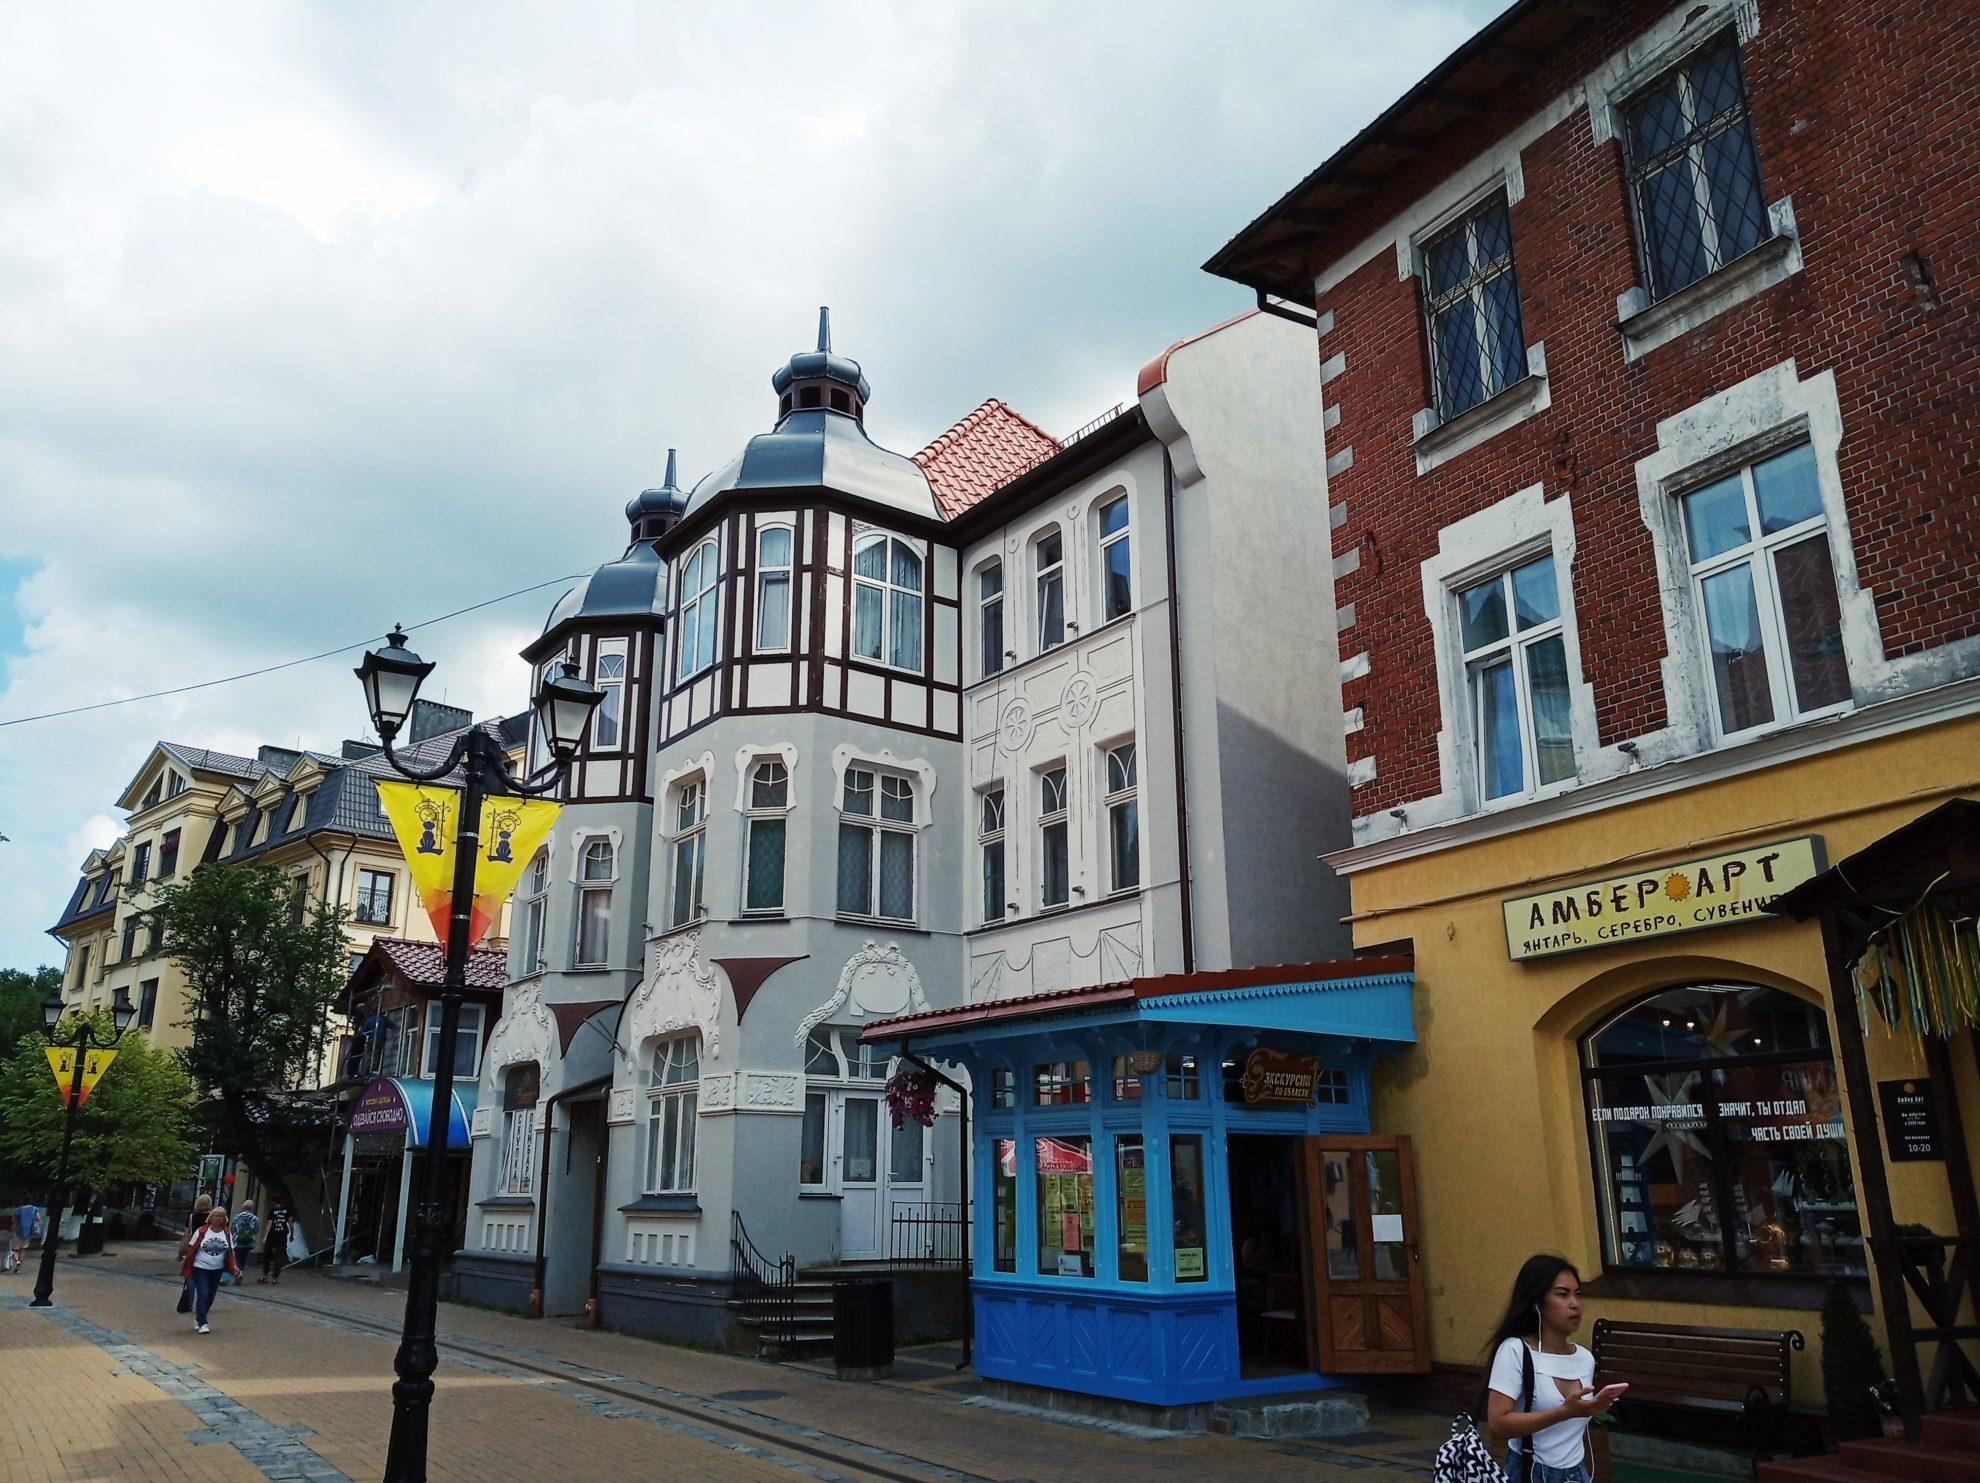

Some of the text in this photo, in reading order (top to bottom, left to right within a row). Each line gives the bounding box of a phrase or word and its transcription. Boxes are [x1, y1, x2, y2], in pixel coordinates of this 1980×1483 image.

[1529, 852, 1780, 930] АМБЕР АРТ
[1523, 931, 1587, 954] ЯНТАРЬ,
[1598, 912, 1682, 940] СЕРЕБРО,
[1263, 1071, 1312, 1087] ЭКСКУРСИИ
[1274, 1086, 1309, 1098] ПО ОБЛАСТИ
[1592, 1099, 1806, 1122] ЕСЛИ ПОДАРОК ПОНРАВИЛСЯ ЗНАЧИТ, ТЫ ОТДАЛ
[1751, 1121, 1846, 1141] ЧАСТЬ СВОЕЙ ДУШИ
[513, 1112, 523, 1181] СКУПКА
[1908, 1143, 1931, 1153] 10-20
